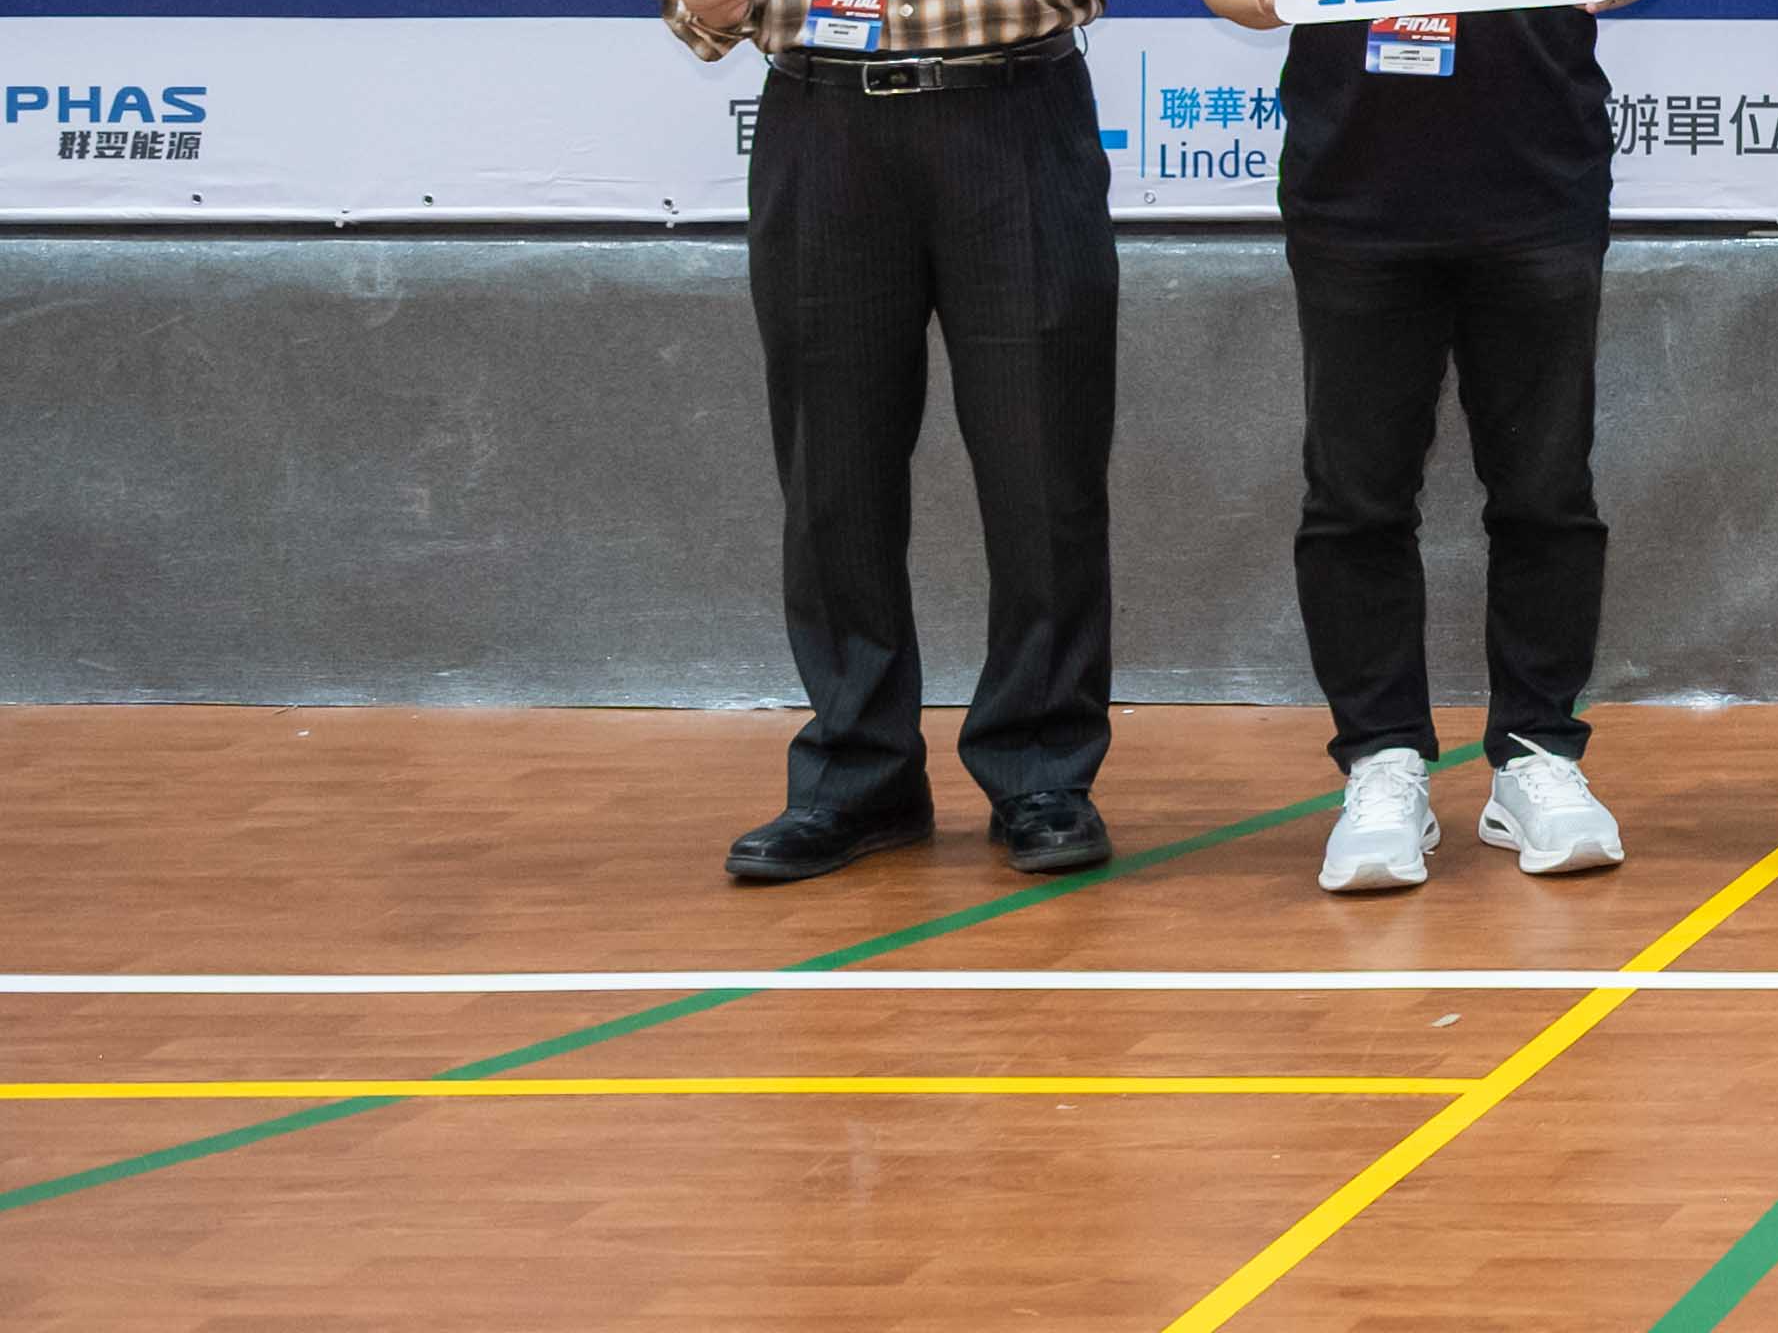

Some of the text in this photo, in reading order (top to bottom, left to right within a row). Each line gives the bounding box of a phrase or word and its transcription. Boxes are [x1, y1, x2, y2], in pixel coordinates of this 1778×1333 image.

[1393, 17, 1451, 33] FINAL
[58, 129, 202, 161] 群翌能源
[1160, 139, 1267, 179] Linde
